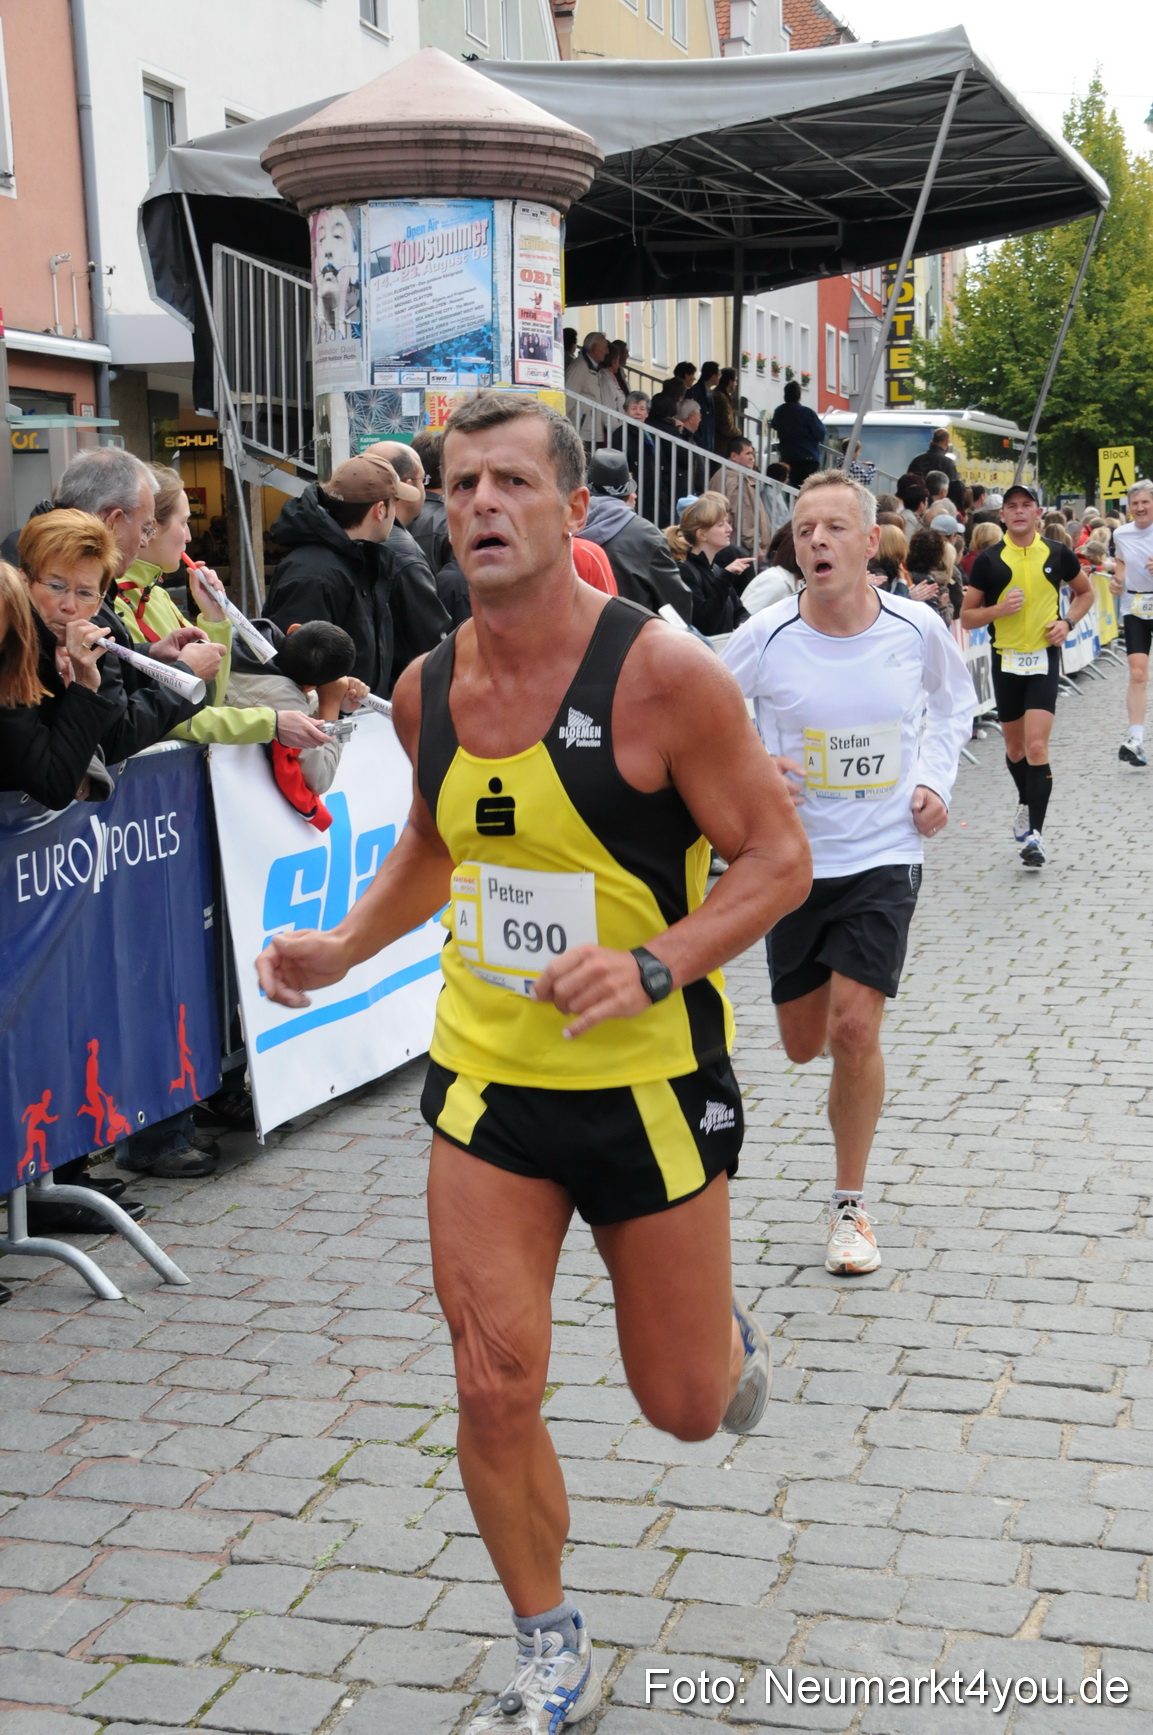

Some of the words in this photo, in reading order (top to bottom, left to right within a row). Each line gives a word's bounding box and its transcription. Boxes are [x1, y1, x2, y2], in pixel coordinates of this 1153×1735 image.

[406, 224, 426, 240] Open
[427, 218, 440, 232] Air
[390, 218, 489, 272] Kinosommer
[423, 252, 468, 275] August
[520, 268, 552, 286] OBI
[521, 309, 537, 320] Freitag
[1103, 449, 1130, 460] Block
[1108, 463, 1127, 487] A
[1018, 656, 1039, 667] 207
[559, 725, 602, 739] BLOEMEN
[575, 739, 601, 748] Collection
[830, 734, 870, 750] Stefan
[808, 756, 815, 766] A
[840, 754, 885, 778] 767
[488, 877, 534, 905] Peter
[459, 909, 468, 926] A
[503, 918, 567, 955] 690
